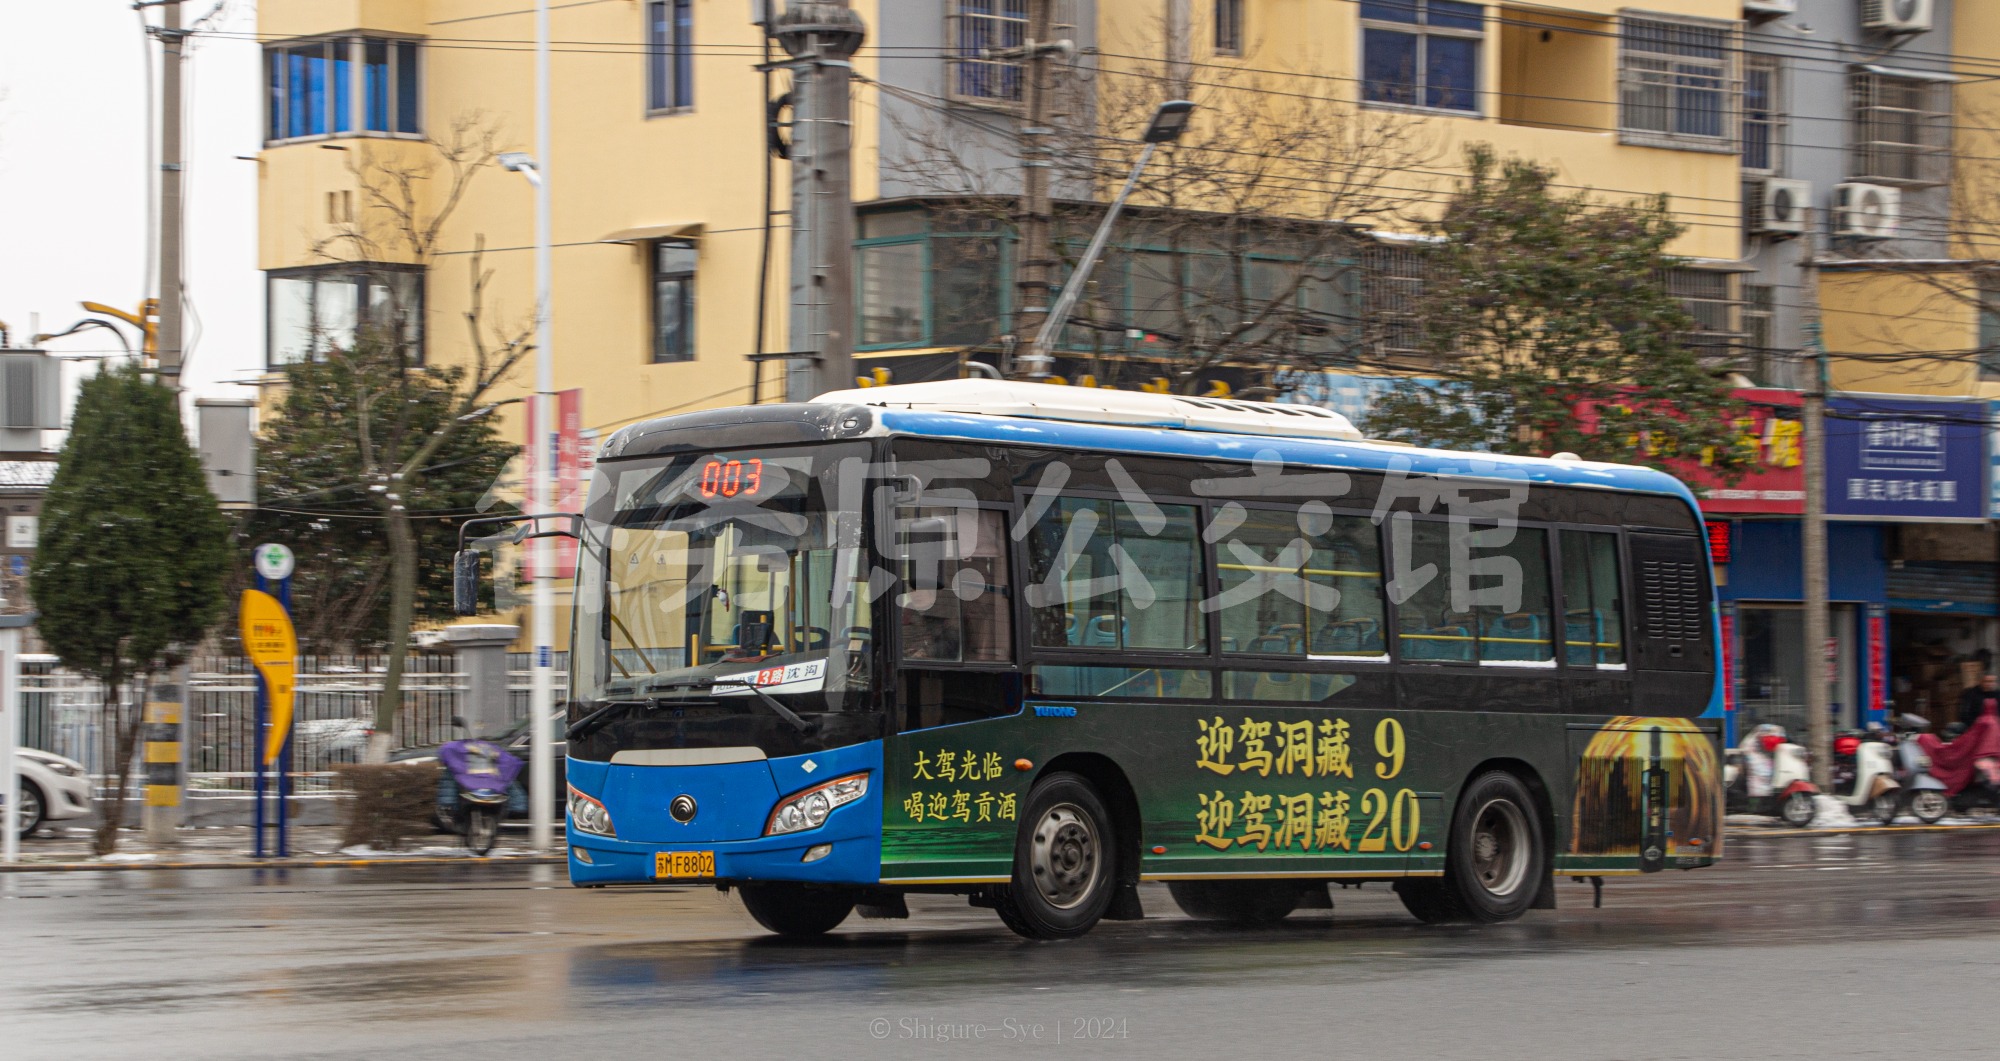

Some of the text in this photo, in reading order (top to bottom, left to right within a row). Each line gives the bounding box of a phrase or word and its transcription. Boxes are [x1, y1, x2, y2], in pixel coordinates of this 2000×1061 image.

[701, 457, 762, 498] 003
[1033, 705, 1077, 717] YUTONG
[912, 749, 1003, 783] 大驾光临
[1196, 716, 1406, 780] 迎驾洞藏 9
[903, 790, 1016, 823] 喝迎驾贡酒
[1195, 788, 1421, 852] 迎驾洞藏 20
